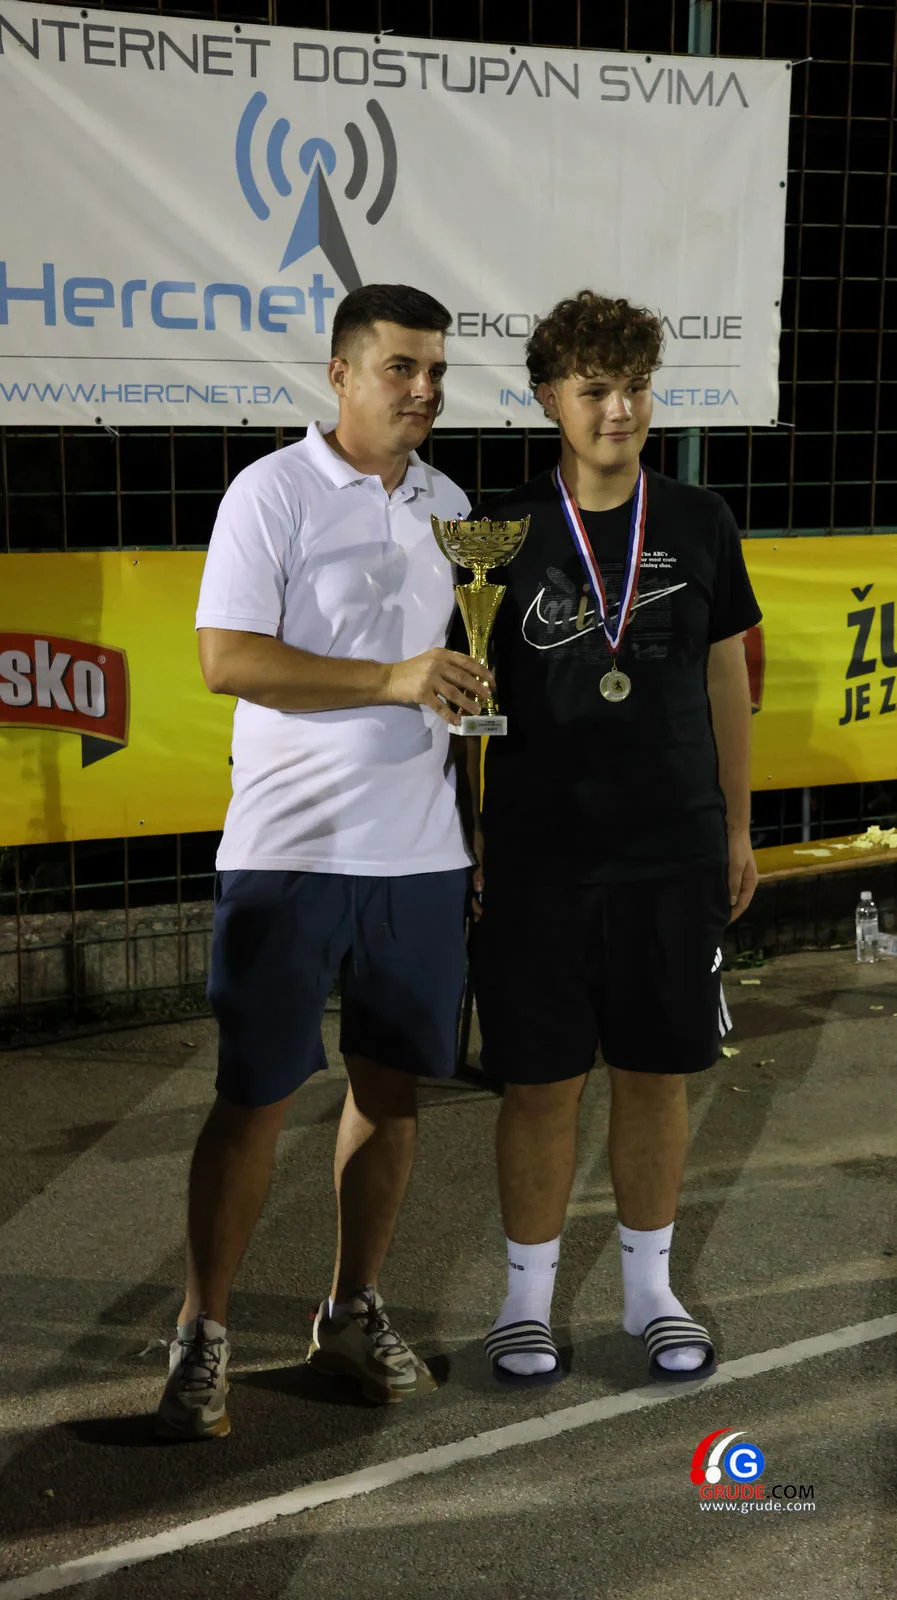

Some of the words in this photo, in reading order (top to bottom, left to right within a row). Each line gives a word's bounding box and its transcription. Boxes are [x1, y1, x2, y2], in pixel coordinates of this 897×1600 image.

[293, 42, 579, 99] DOSTUPAN
[600, 65, 749, 108] SVIMA
[0, 261, 335, 334] Hercnet
[0, 383, 293, 404] WWW.HERCNET.BA
[839, 683, 870, 725] JE
